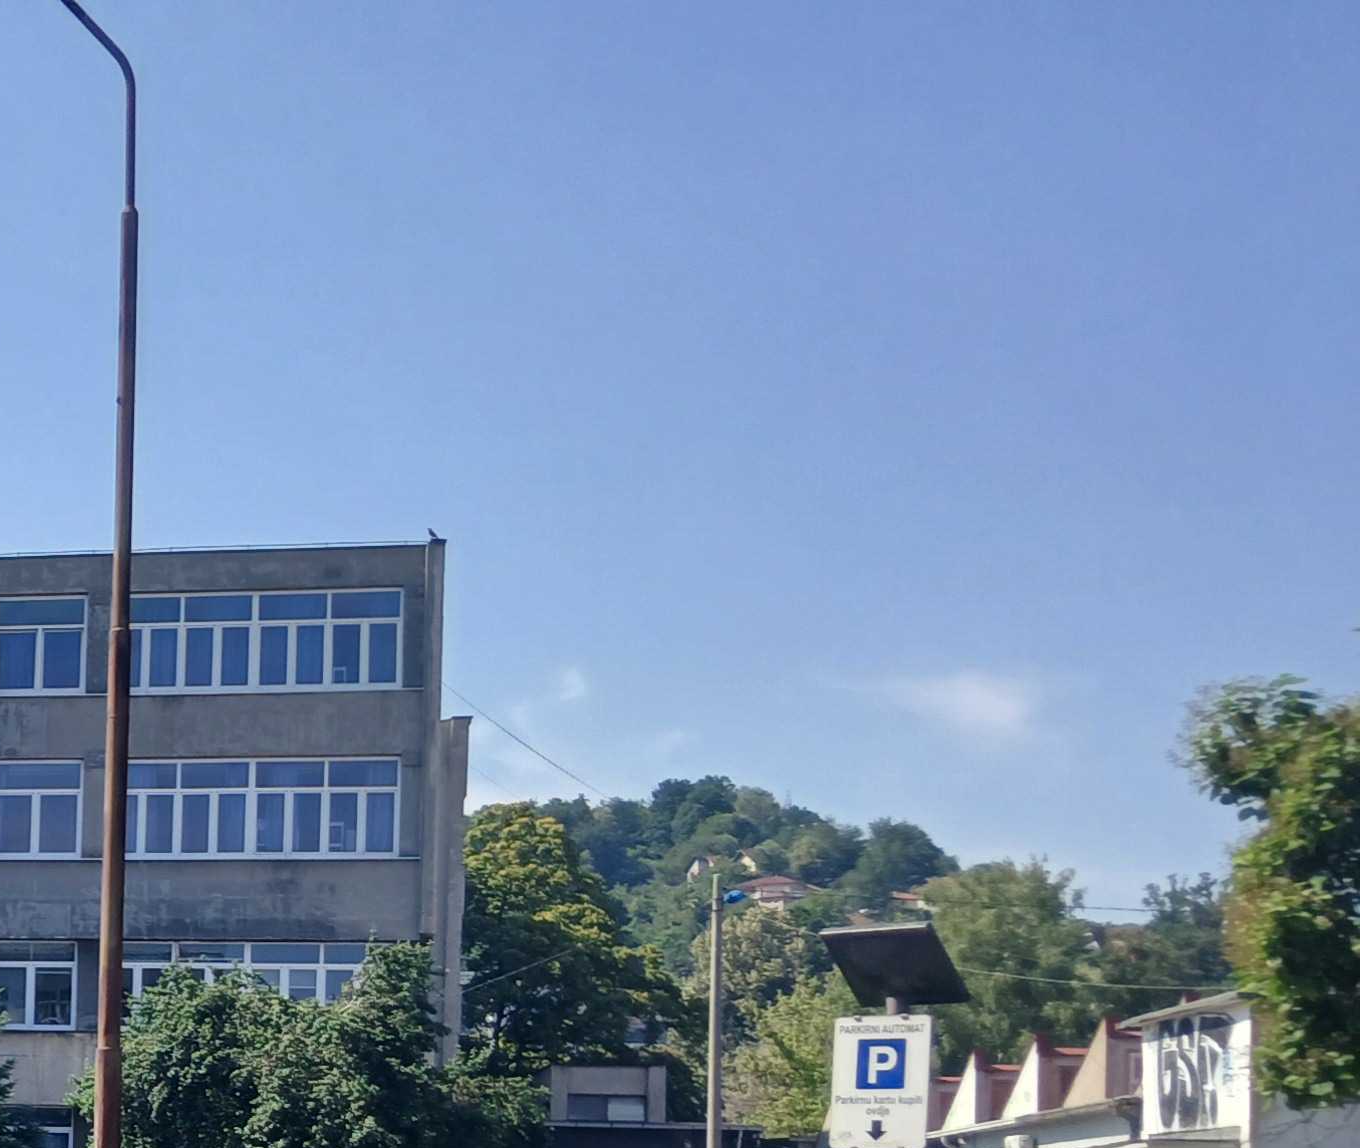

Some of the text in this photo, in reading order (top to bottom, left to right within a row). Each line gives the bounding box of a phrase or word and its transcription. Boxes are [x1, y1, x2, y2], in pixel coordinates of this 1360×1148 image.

[839, 1023, 925, 1034] PARKIRNI AUTOMAT
[867, 1045, 898, 1084] P
